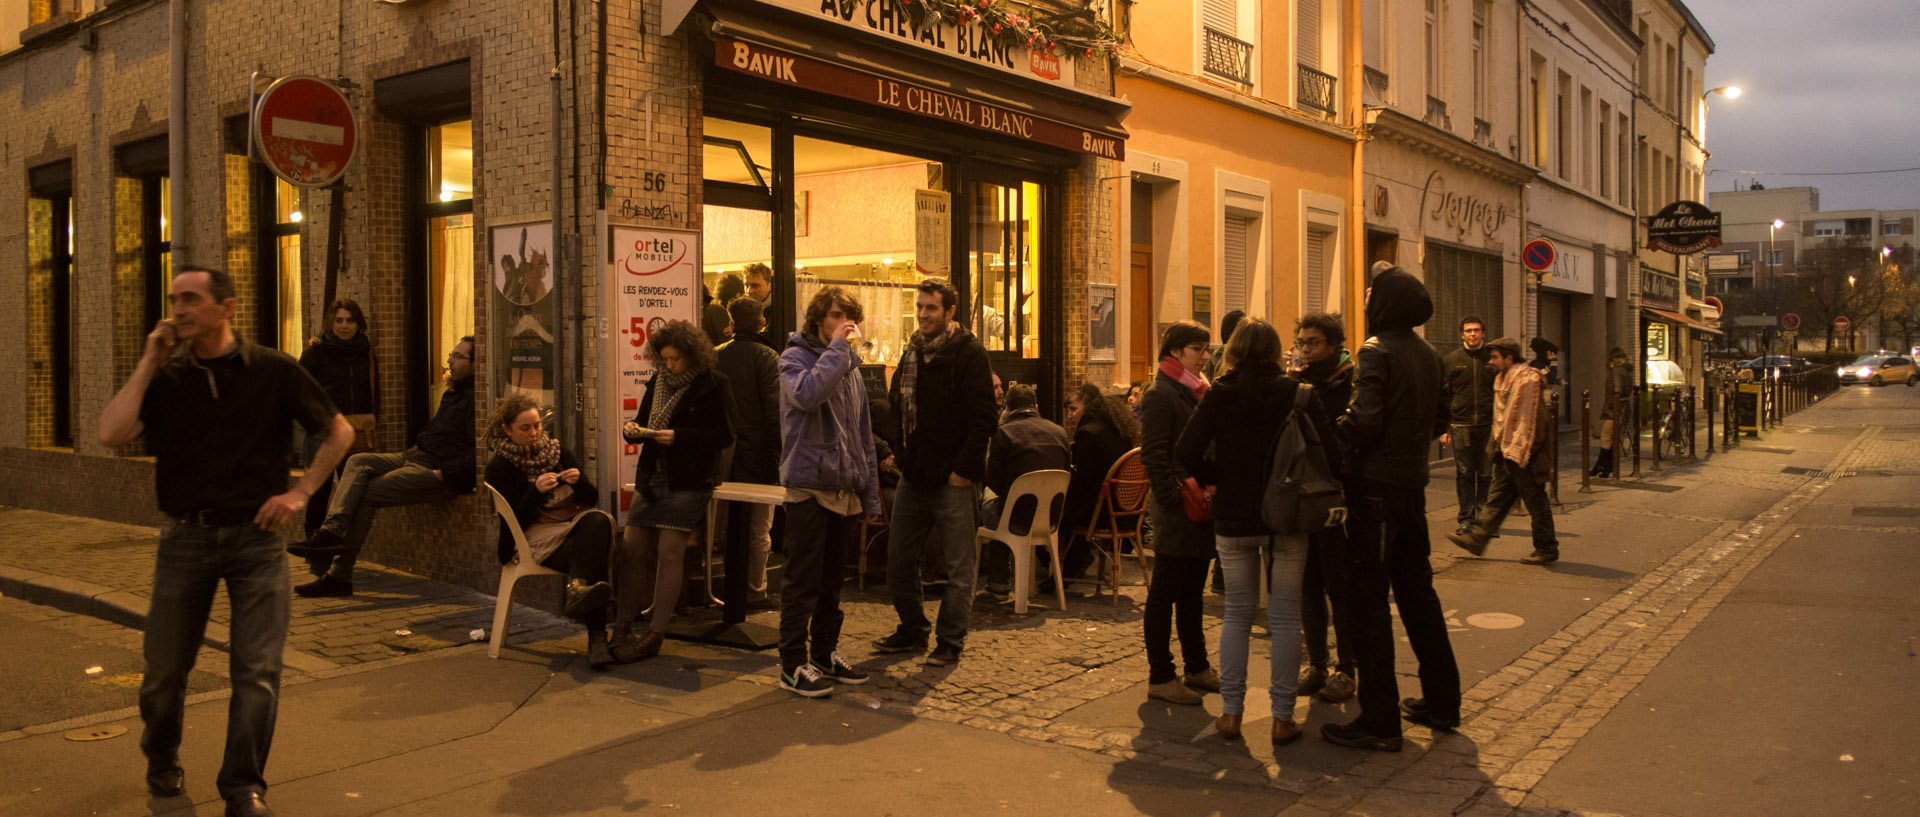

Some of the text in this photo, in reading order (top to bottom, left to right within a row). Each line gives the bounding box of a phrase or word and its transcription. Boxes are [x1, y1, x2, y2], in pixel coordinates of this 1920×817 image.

[821, 0, 854, 22] AU
[732, 41, 798, 84] BAVIK
[1032, 54, 1059, 76] BAVIK
[877, 79, 1033, 138] LE CHEVAL BLANC
[1082, 132, 1117, 158] BAVIK
[644, 172, 666, 192] 56
[1673, 203, 1692, 215] Le
[635, 238, 674, 254] ortel
[1657, 238, 1711, 253] RESTAURANT
[635, 253, 674, 262] MOBILE
[623, 285, 689, 297] LES RENDEZ-VOUS
[639, 298, 669, 308] D'ORTEL
[636, 368, 649, 376] tout
